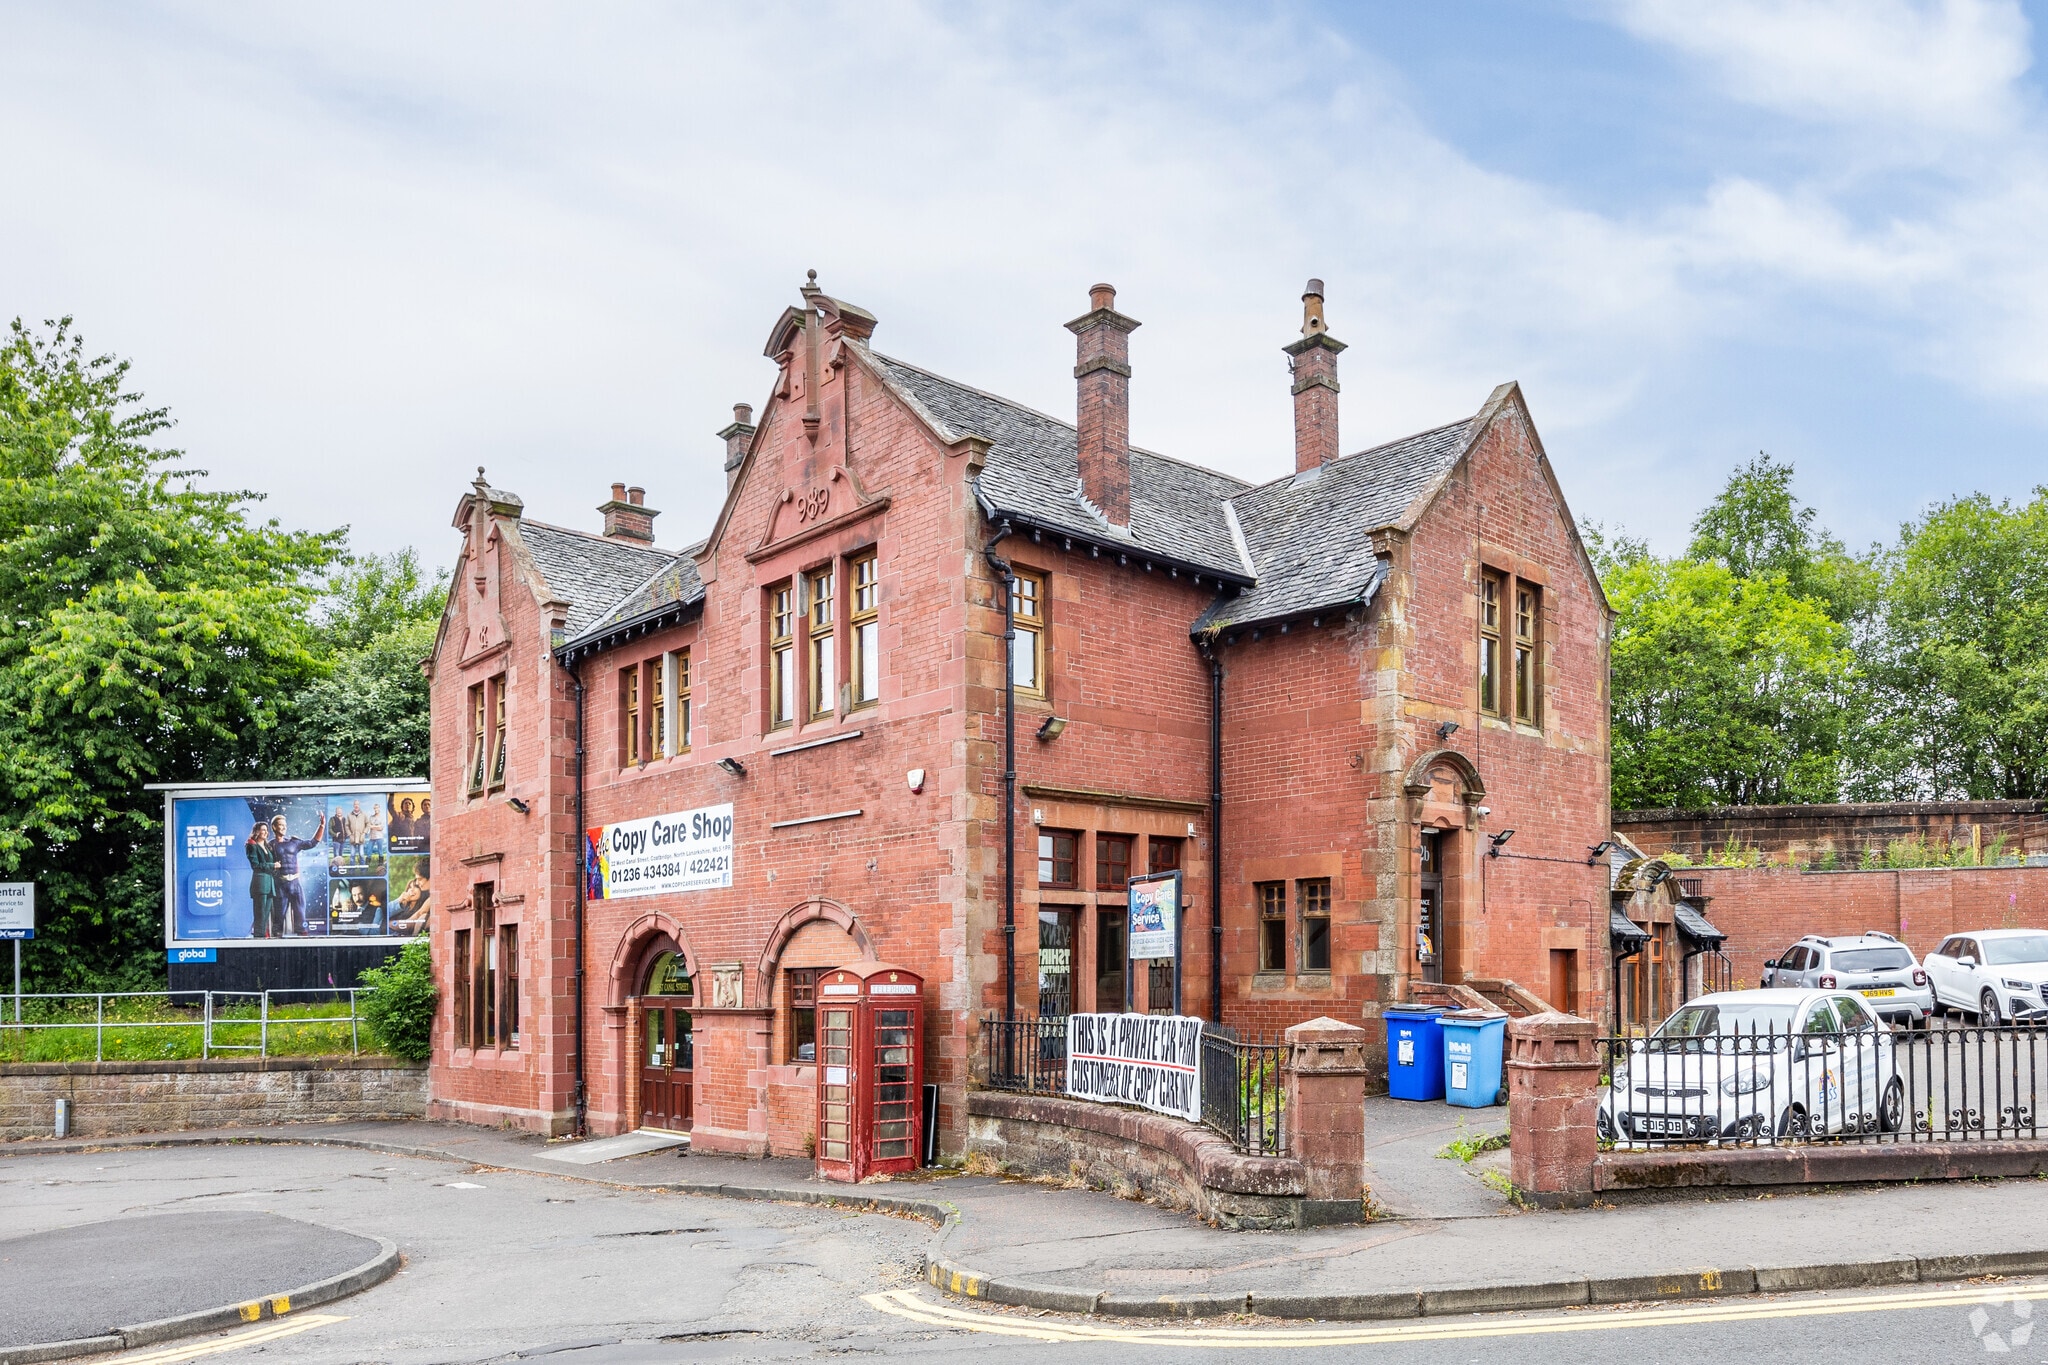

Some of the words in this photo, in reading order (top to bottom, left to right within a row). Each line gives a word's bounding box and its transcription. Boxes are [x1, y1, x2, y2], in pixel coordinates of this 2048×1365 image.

[612, 828, 646, 855] Copy
[652, 820, 686, 846] Care
[692, 812, 732, 842] Shop
[187, 835, 235, 847] RIGHT
[188, 846, 226, 858] HERE
[612, 868, 640, 883] 01236
[643, 862, 680, 879] 434384
[690, 856, 729, 874] 422421
[195, 878, 223, 890] prime
[661, 878, 720, 889] WWW.COPYCARESERVICE.NET
[195, 888, 223, 898] video
[1136, 892, 1154, 905] Copy
[1155, 889, 1172, 901] Care
[1132, 912, 1160, 925] Service
[178, 949, 206, 962] global
[665, 964, 676, 982] 22
[676, 983, 688, 991] STREET
[1073, 1016, 1094, 1054] THIS
[1097, 1016, 1107, 1055] IS
[1110, 1018, 1117, 1056] A
[1119, 1018, 1160, 1060] PRIVATE
[1161, 1020, 1176, 1063] CAR
[1072, 1059, 1121, 1097] CUSTOMERS
[1121, 1064, 1134, 1100] OF
[1134, 1066, 1159, 1105] COPY
[1160, 1069, 1180, 1110] CARE
[1819, 1086, 1837, 1104] ESS
